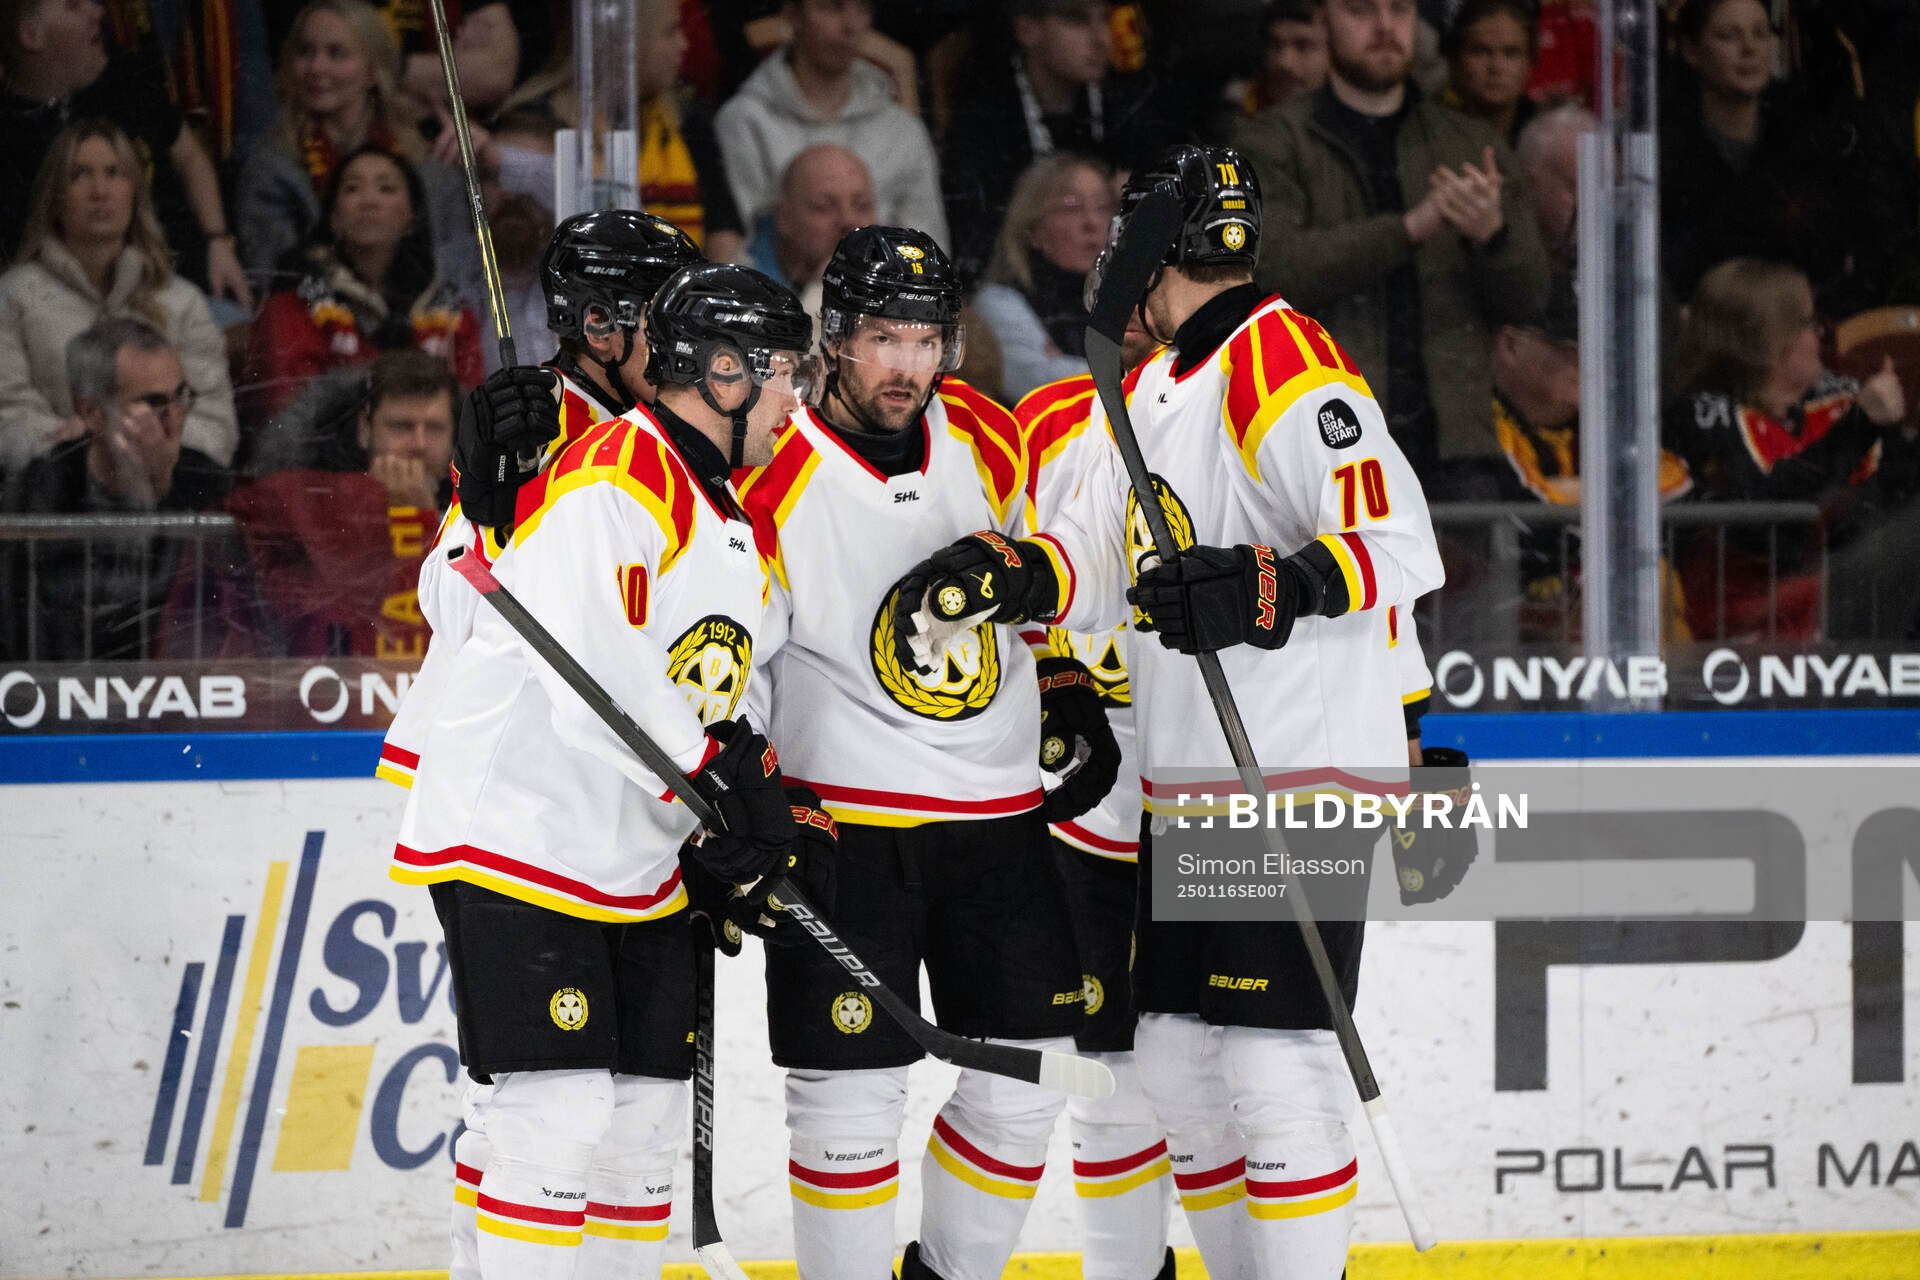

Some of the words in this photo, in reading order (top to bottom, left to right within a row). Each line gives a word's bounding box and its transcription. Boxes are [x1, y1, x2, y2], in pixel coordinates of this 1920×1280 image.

[1216, 163, 1239, 186] 70
[911, 262, 924, 275] 15
[1320, 409, 1335, 424] EN
[1323, 417, 1346, 435] BRA
[1328, 425, 1358, 445] START
[893, 490, 920, 503] SHL
[1331, 457, 1391, 531] 70
[728, 537, 747, 553] SHL
[709, 621, 737, 646] 1912
[1493, 656, 1668, 700] NYAB
[58, 675, 246, 720] NYAB
[1495, 1144, 1777, 1195] POLAR
